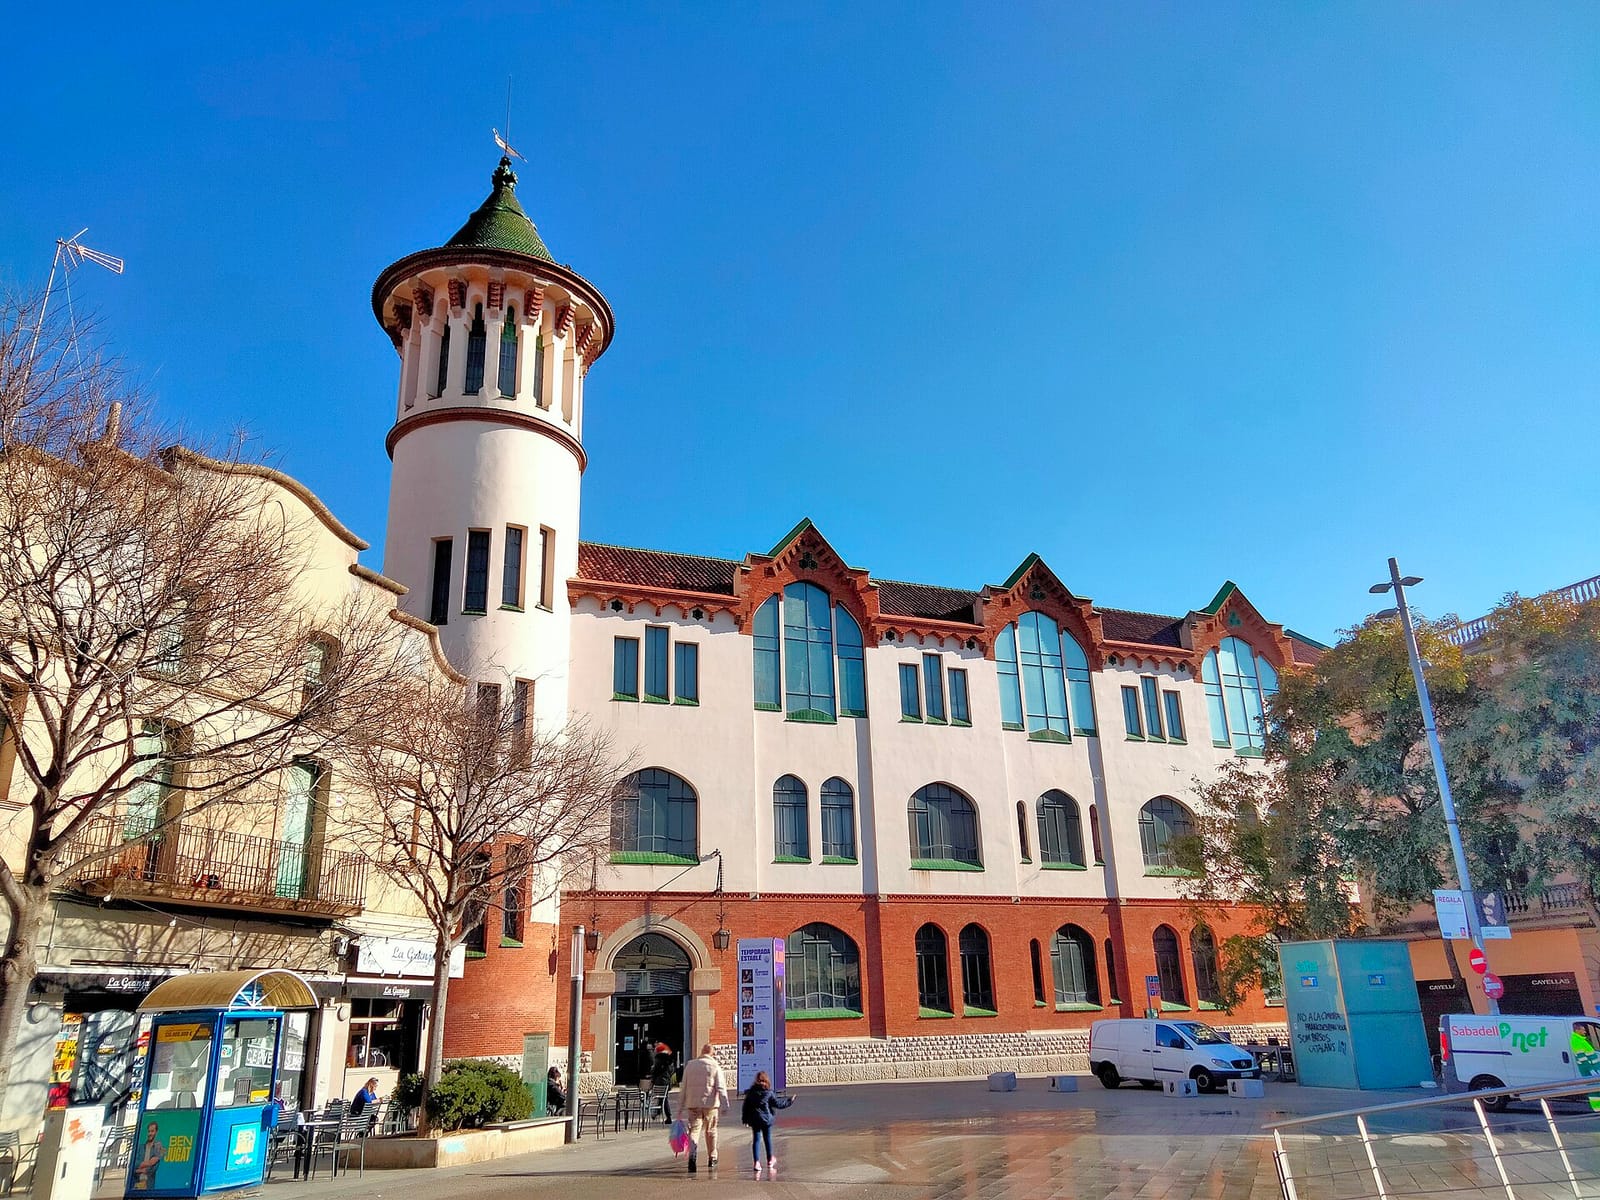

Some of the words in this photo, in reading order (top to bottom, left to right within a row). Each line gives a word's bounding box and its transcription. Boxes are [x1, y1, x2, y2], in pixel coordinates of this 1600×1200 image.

[392, 946, 404, 959] La
[106, 977, 120, 987] La
[121, 977, 150, 989] Granja
[1452, 1025, 1499, 1037] Sabadell
[169, 1135, 193, 1147] BEN
[164, 1147, 191, 1162] JUGAT
